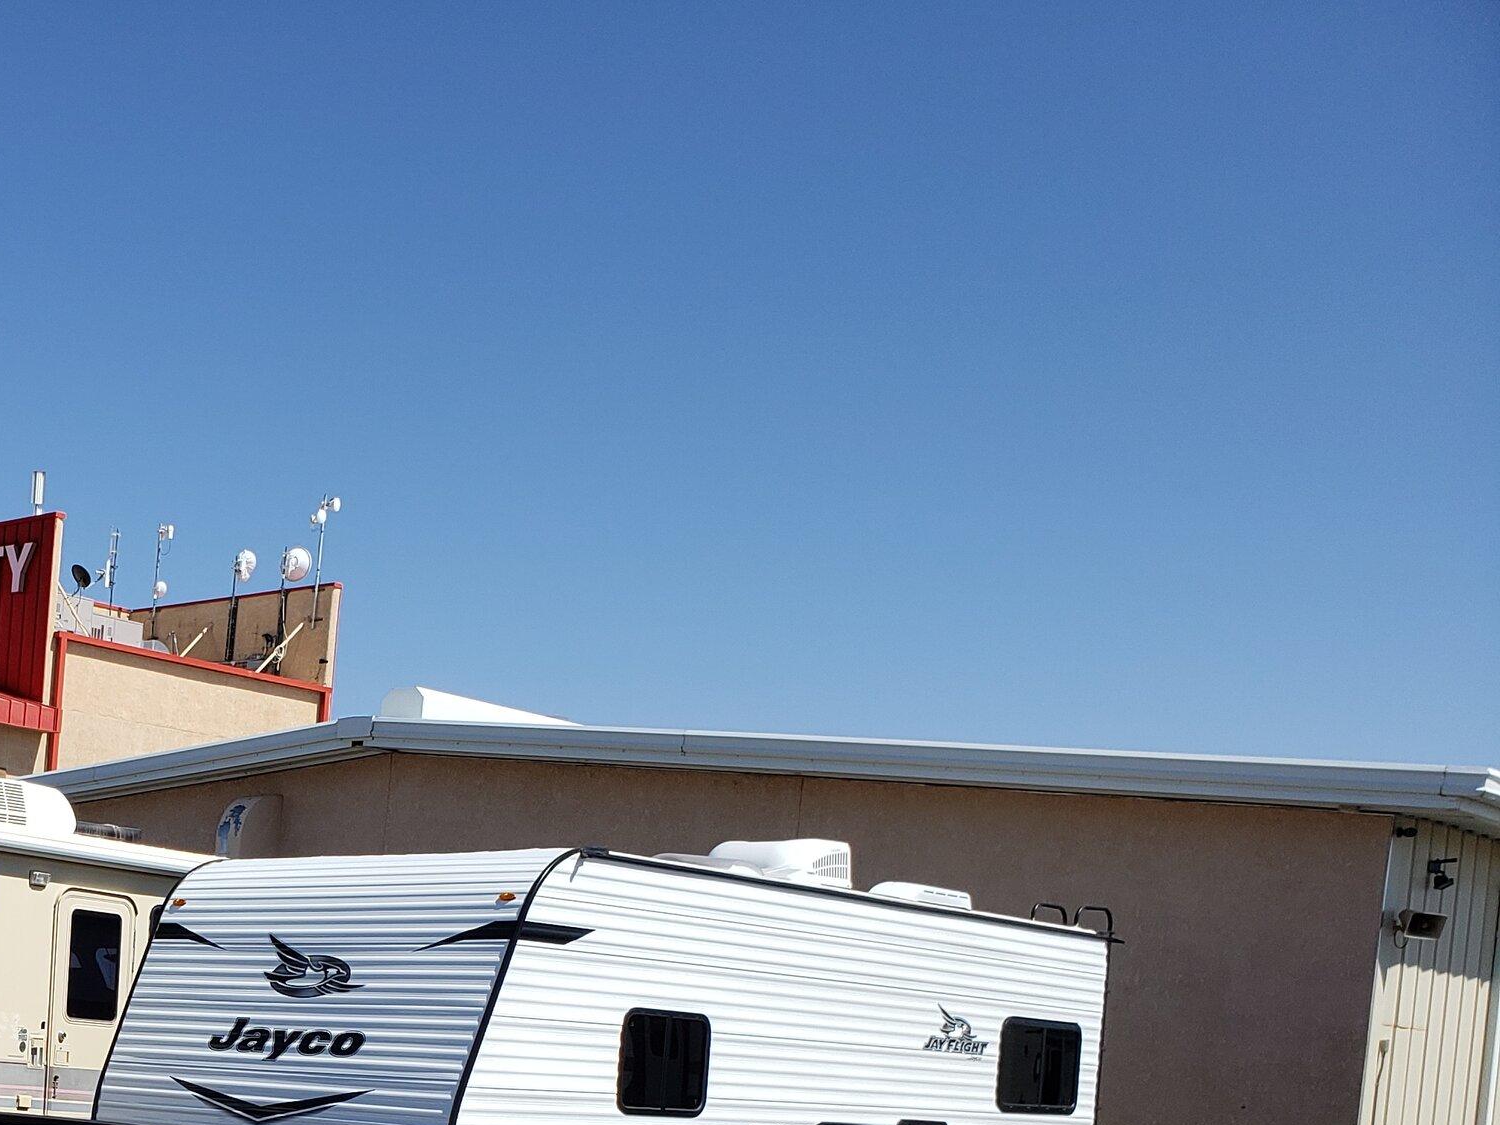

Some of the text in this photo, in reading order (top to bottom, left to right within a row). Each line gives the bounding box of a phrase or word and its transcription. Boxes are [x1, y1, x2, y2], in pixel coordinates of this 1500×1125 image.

[207, 1016, 367, 1062] Jayco
[924, 1036, 989, 1055] JAY FLIGHT
